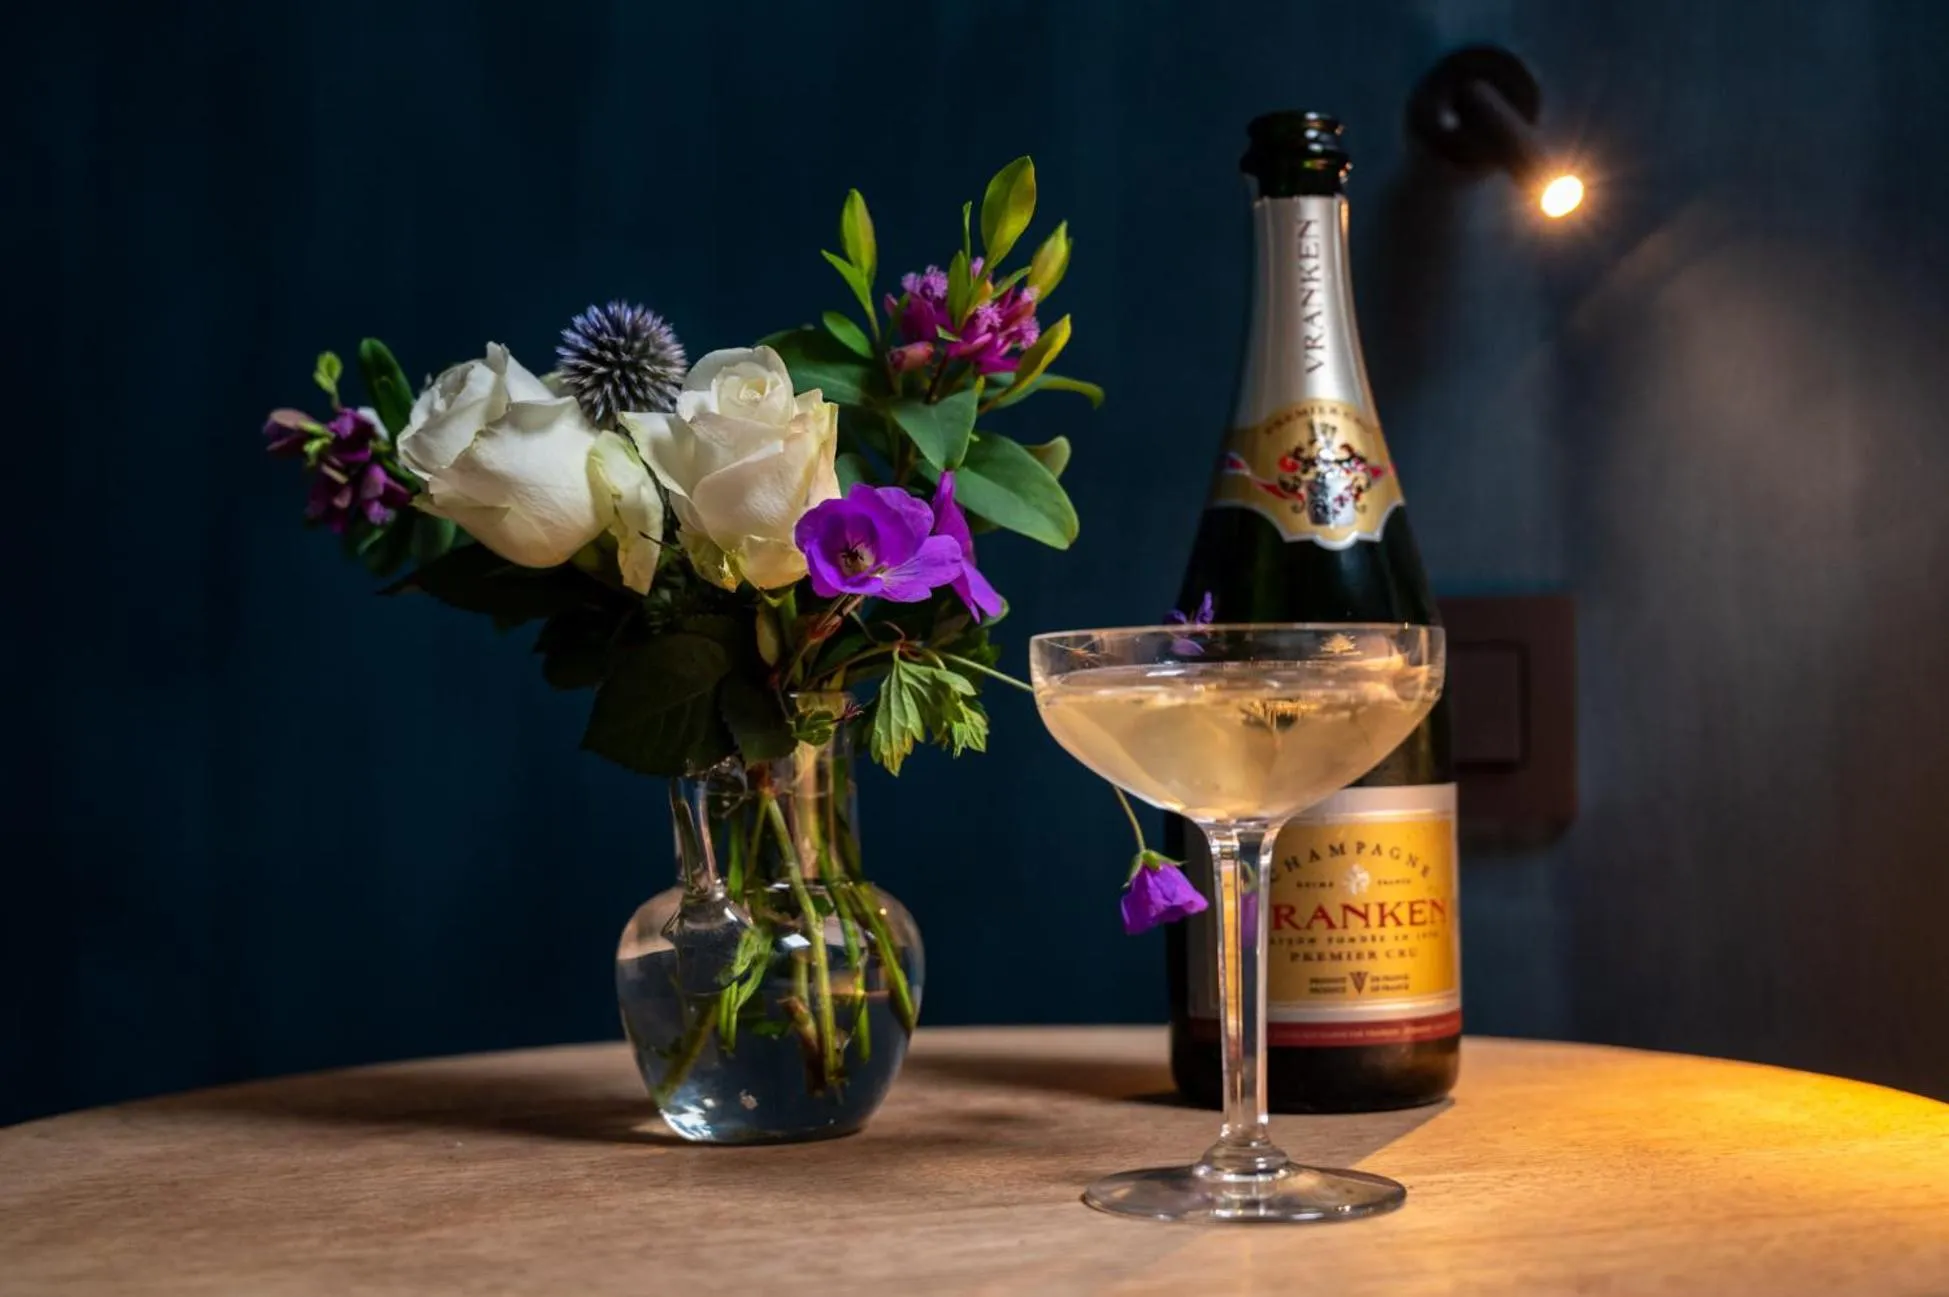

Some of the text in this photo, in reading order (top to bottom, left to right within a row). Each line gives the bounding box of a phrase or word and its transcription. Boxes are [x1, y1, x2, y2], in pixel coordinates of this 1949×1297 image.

[1297, 219, 1326, 375] VRANKEN
[1270, 841, 1431, 883] CHAMPAGNE
[1272, 899, 1447, 931] RANKEN
[1290, 948, 1418, 962] PREMIER CRU
